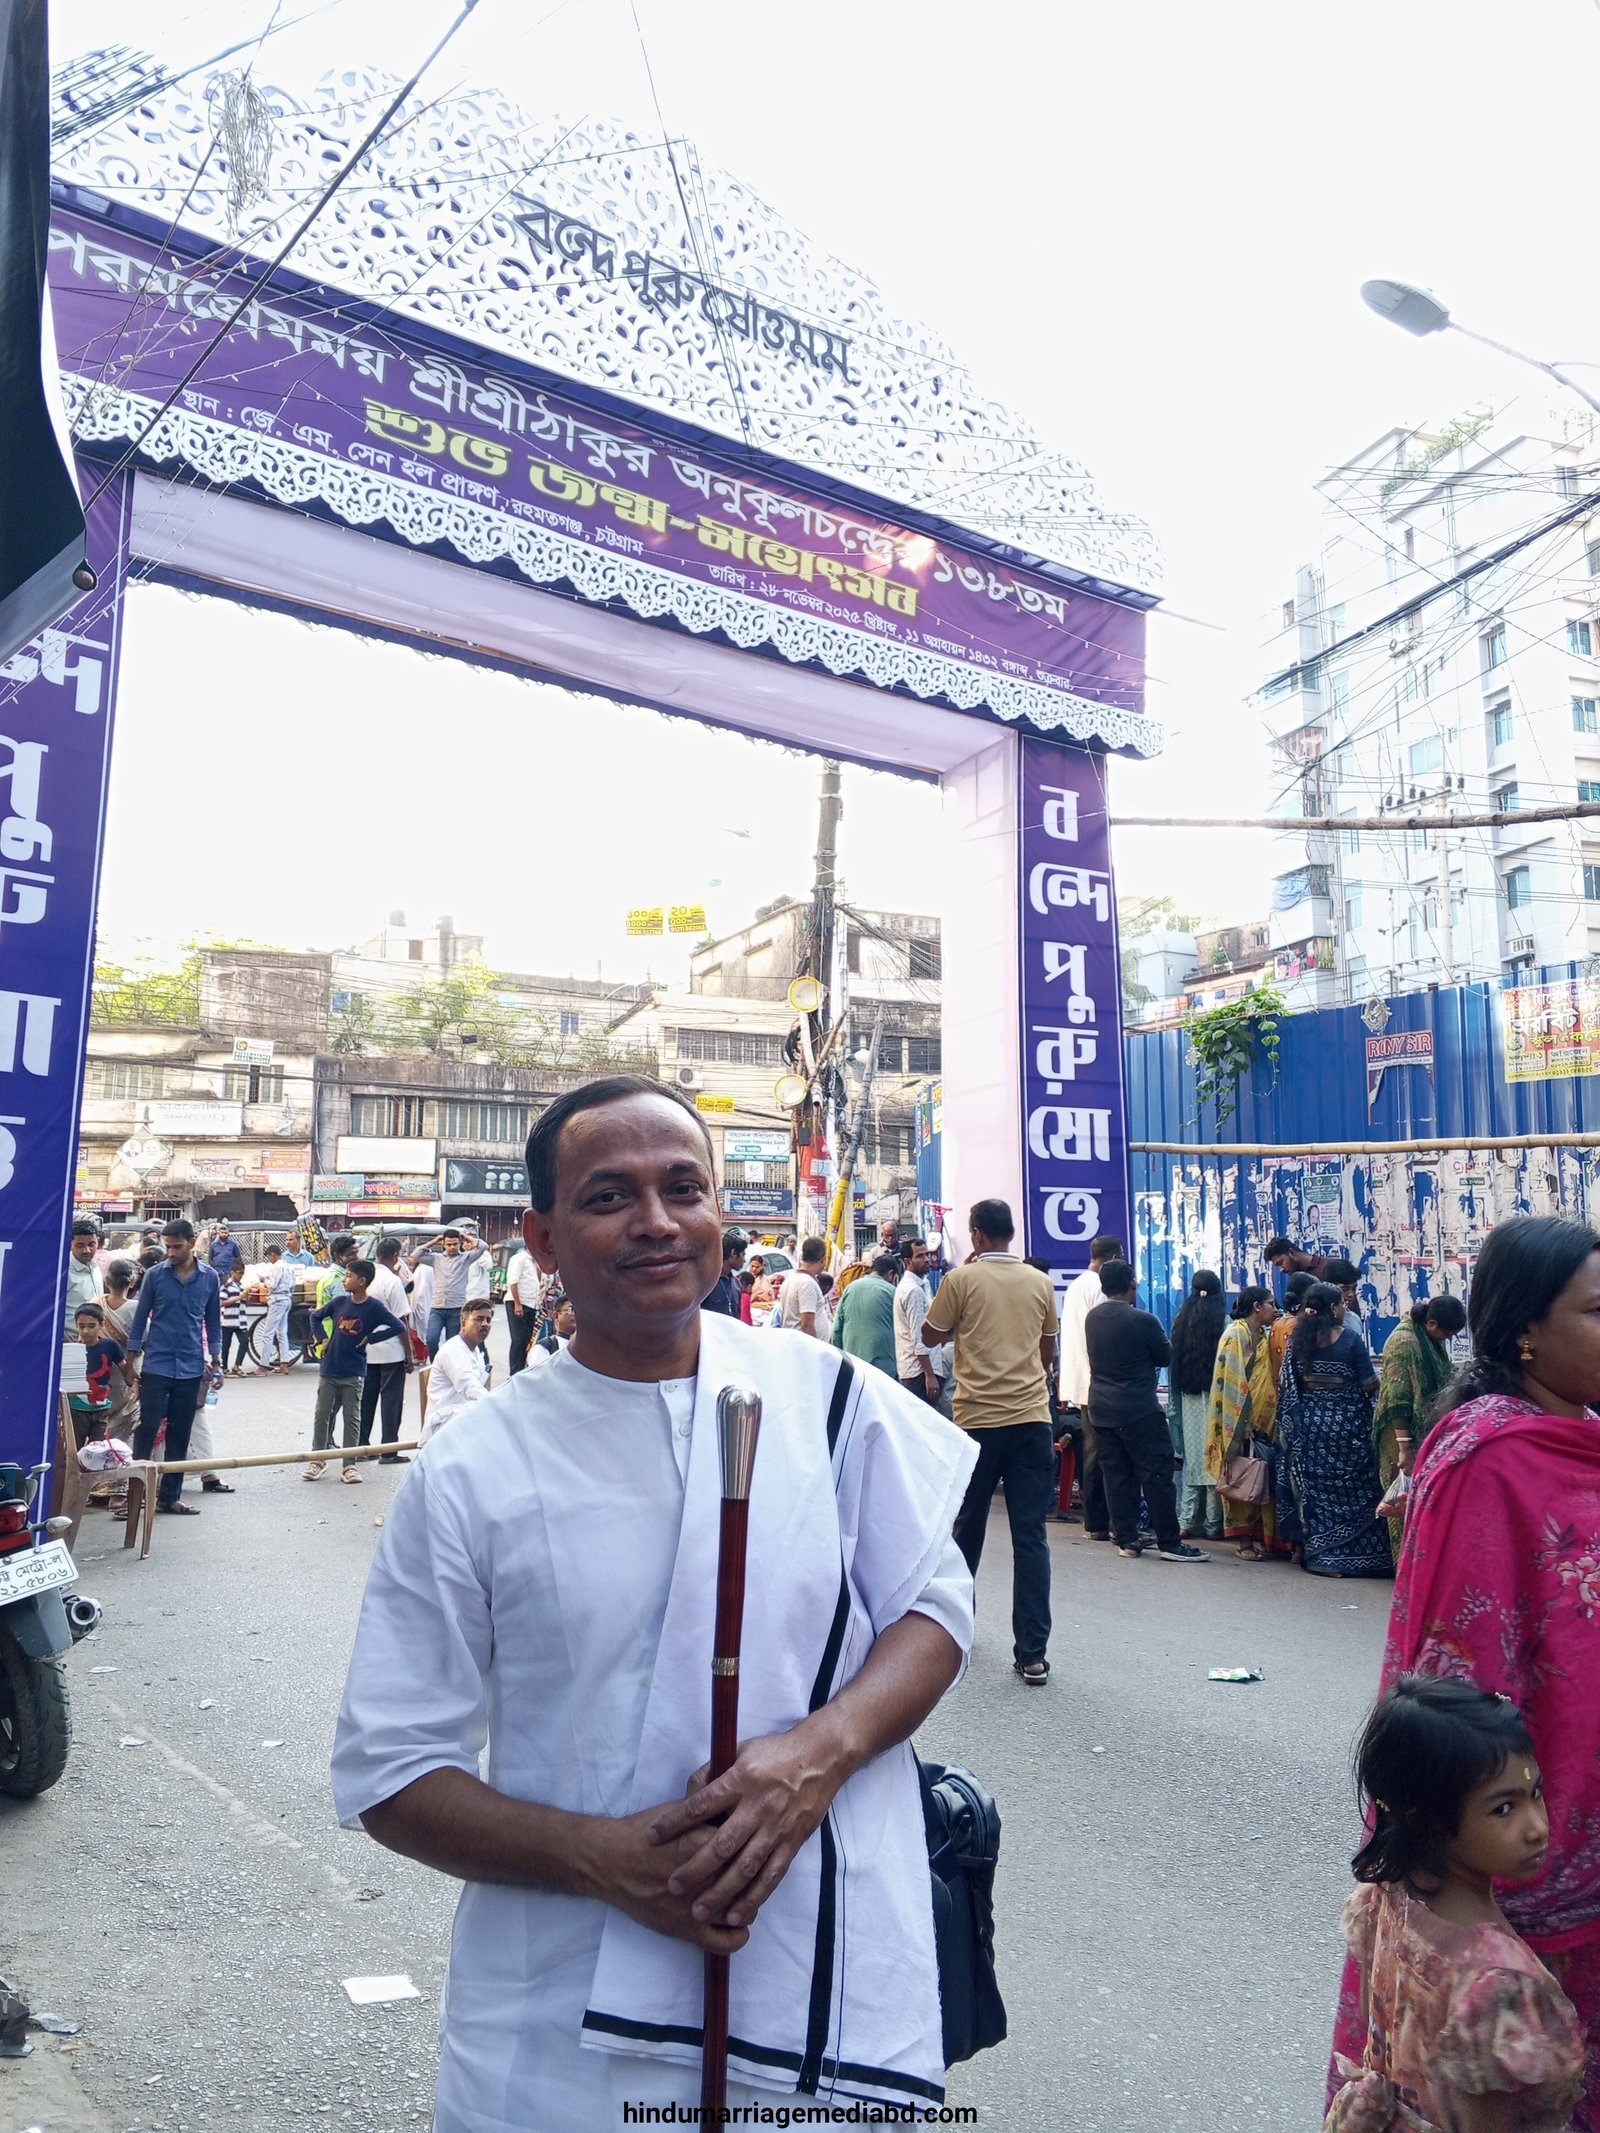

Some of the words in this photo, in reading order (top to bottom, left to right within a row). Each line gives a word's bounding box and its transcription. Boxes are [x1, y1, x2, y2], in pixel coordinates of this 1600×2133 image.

[510, 191, 616, 280] বন্দে
[363, 398, 511, 476] শুভ
[348, 442, 394, 473] সেন
[708, 563, 747, 588] তারিখ
[1406, 1034, 1431, 1052] SIR
